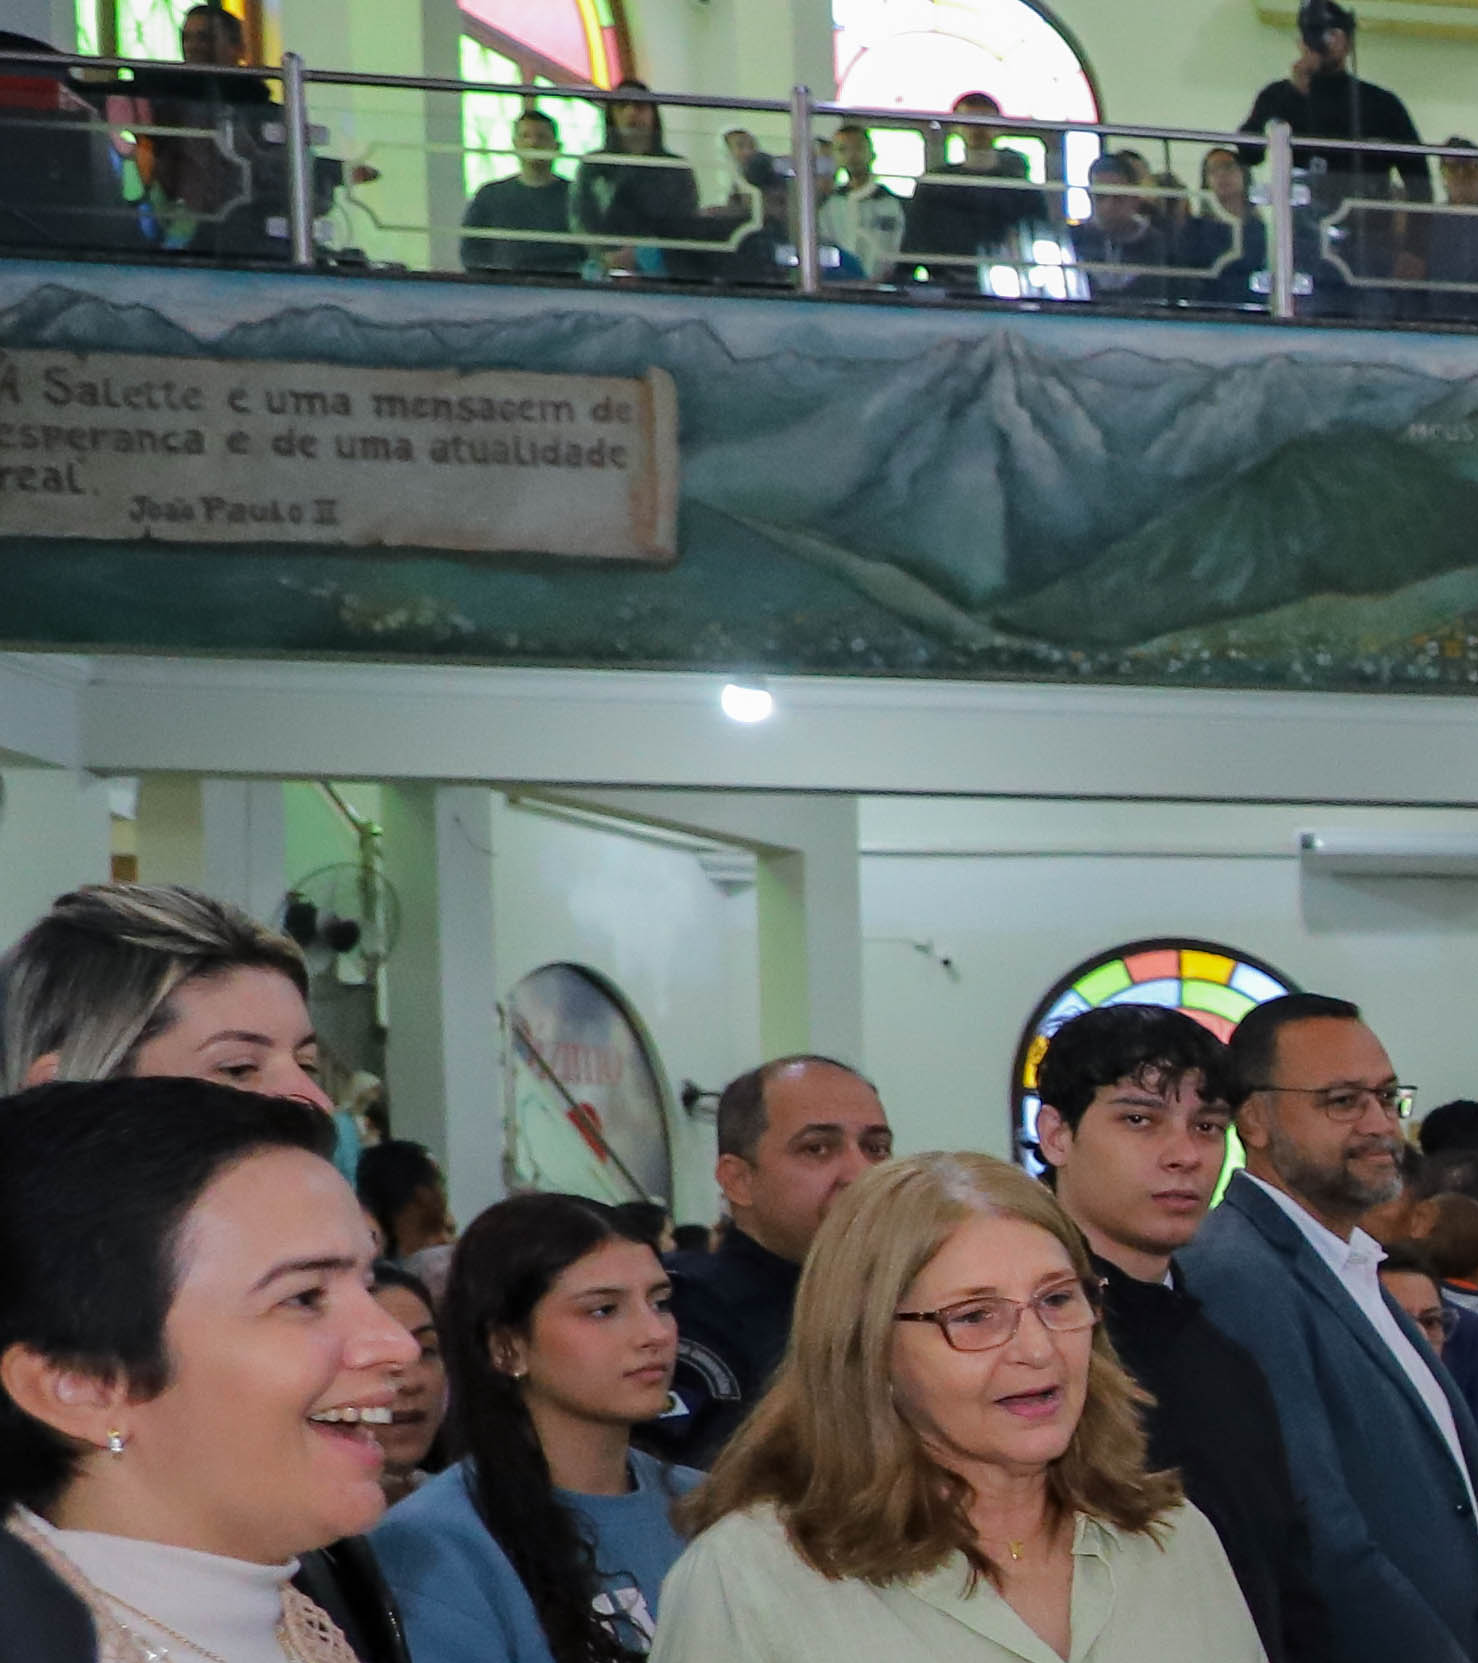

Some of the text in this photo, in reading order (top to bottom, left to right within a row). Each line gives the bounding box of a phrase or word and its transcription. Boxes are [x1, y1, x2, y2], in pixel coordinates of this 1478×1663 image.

[44, 366, 203, 411] Salette
[266, 389, 352, 416] uma
[592, 396, 633, 424] de
[271, 427, 317, 458] de
[335, 434, 414, 462] uma
[430, 434, 628, 470] atualidade
[201, 494, 304, 525] Paulo
[313, 498, 339, 526] II
